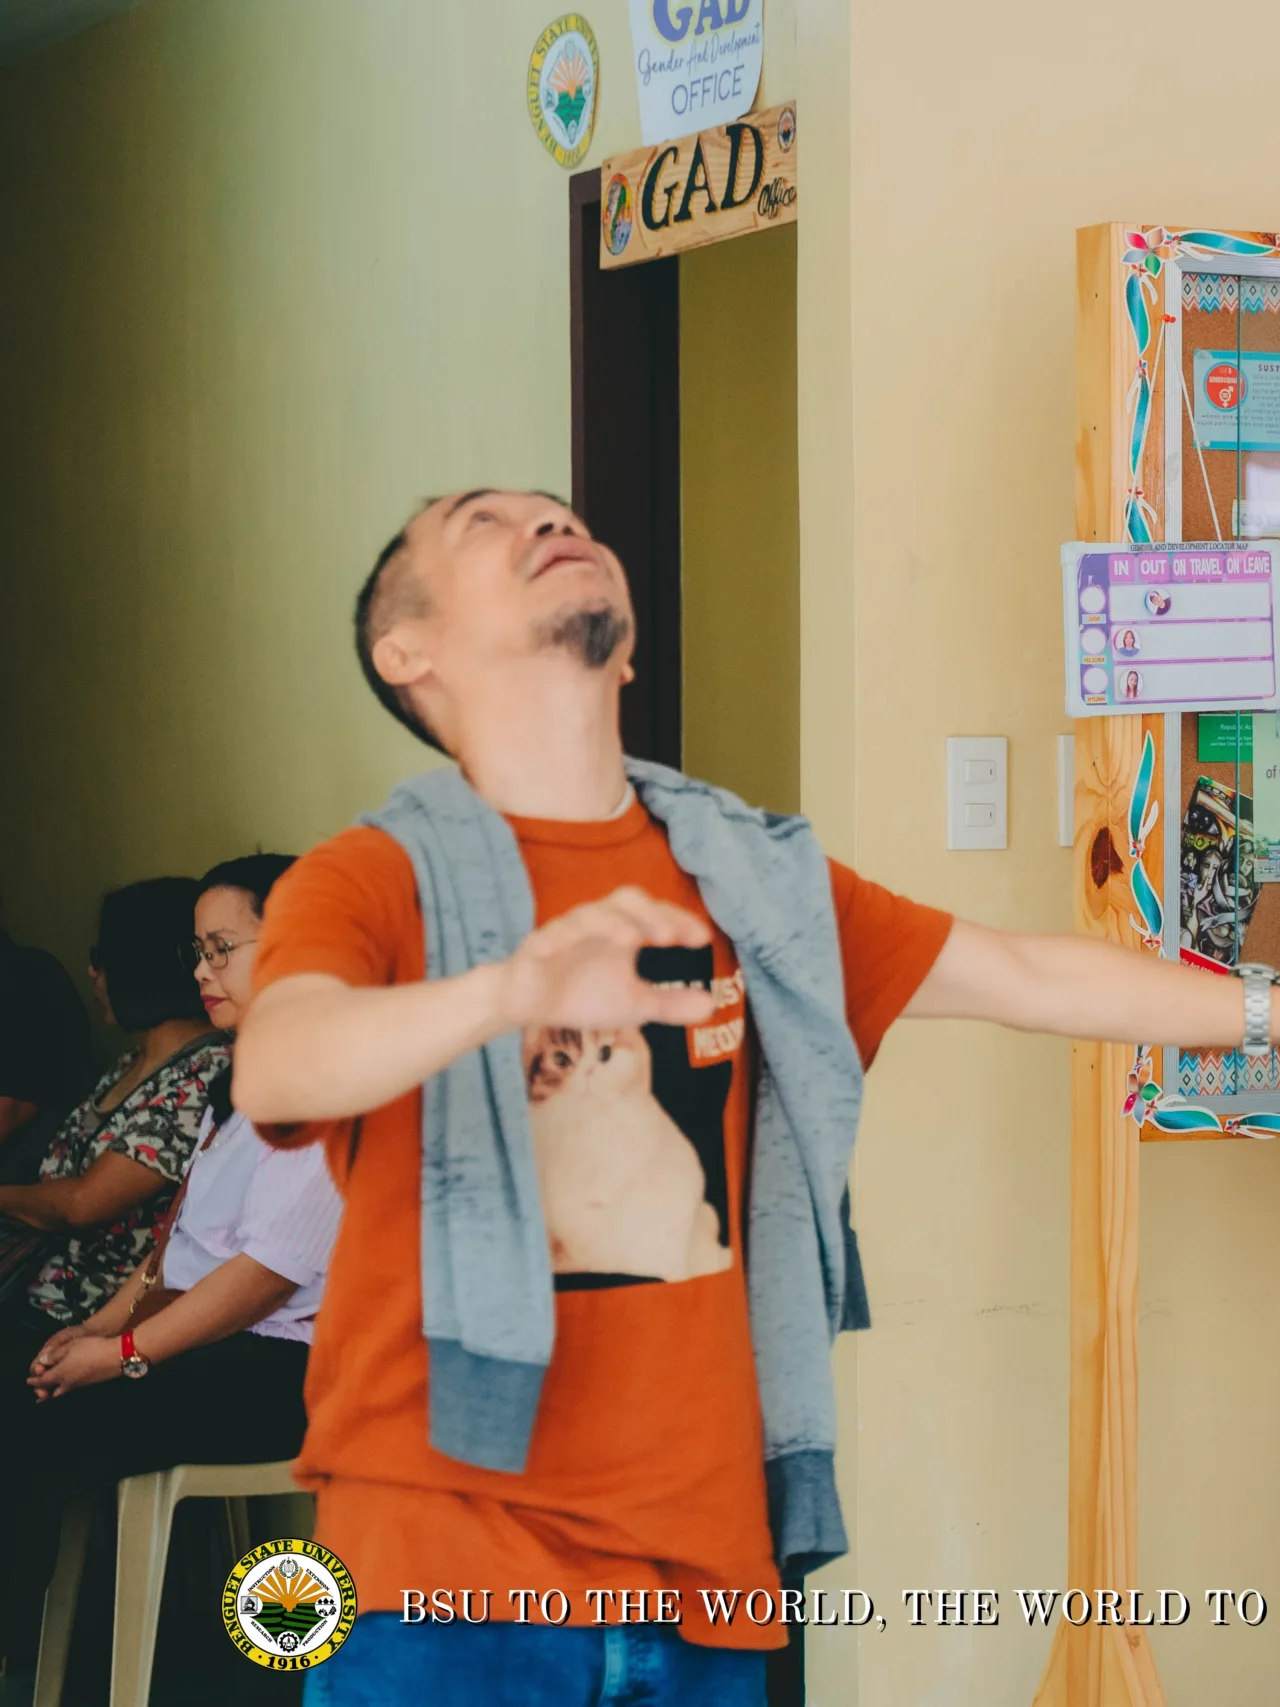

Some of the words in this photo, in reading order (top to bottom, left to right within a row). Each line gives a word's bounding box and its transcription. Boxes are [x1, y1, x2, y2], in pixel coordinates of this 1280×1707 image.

[637, 49, 683, 85] Gender
[686, 43, 710, 76] And
[710, 22, 761, 64] Development
[671, 65, 745, 115] OFFICE
[641, 122, 764, 231] GAD
[757, 176, 797, 219] Office
[1167, 543, 1209, 551] DEVELOPMENT
[1210, 543, 1235, 551] LOCATOR
[1114, 560, 1129, 576] IN
[1140, 560, 1167, 575] OUT
[1173, 559, 1186, 575] ON
[1190, 557, 1223, 575] TRAVEL
[1227, 557, 1240, 574] ON
[1243, 556, 1270, 574] LEAVE
[1266, 765, 1277, 778] of
